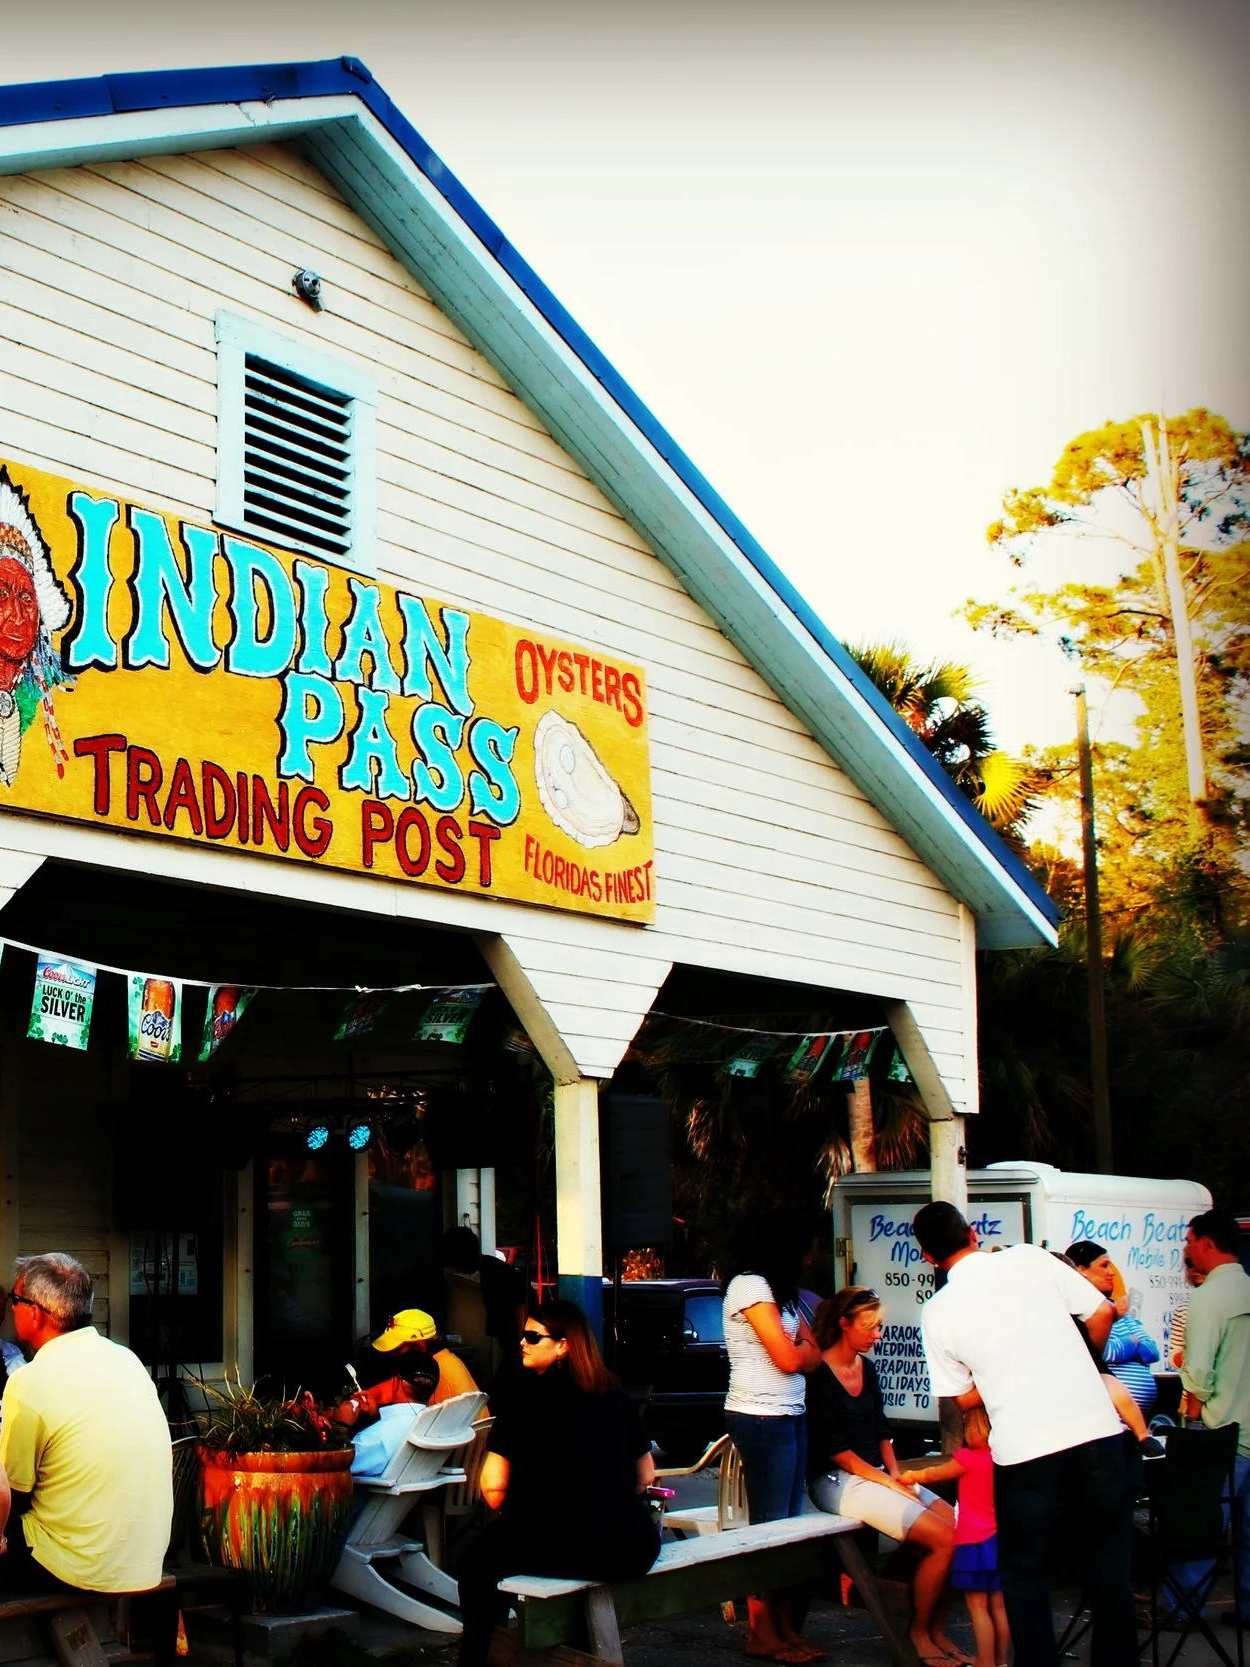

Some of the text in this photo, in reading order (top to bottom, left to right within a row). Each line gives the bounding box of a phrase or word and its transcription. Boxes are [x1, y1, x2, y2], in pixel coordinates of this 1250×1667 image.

[62, 490, 475, 716] INDIAN
[514, 638, 645, 728] OYSTERS
[276, 671, 519, 827] PASS
[74, 733, 502, 888] TRADING POST
[524, 833, 654, 904] FLORIDAS FINEST
[42, 965, 91, 989] Coors LIGHT
[42, 984, 63, 998] LUCK
[74, 991, 87, 1004] the
[40, 996, 86, 1022] SILVER
[869, 1213, 1002, 1243] Beac atz
[1070, 1209, 1190, 1248] Beach Beat
[1126, 1246, 1166, 1270] Mobile
[884, 1272, 934, 1287] 850-99
[879, 1325, 922, 1342] ARAOK
[873, 1341, 925, 1357] WEDDING
[874, 1359, 929, 1376] GRADUAT
[880, 1376, 930, 1392] OLIDAYS
[882, 1393, 930, 1409] USIC TO
